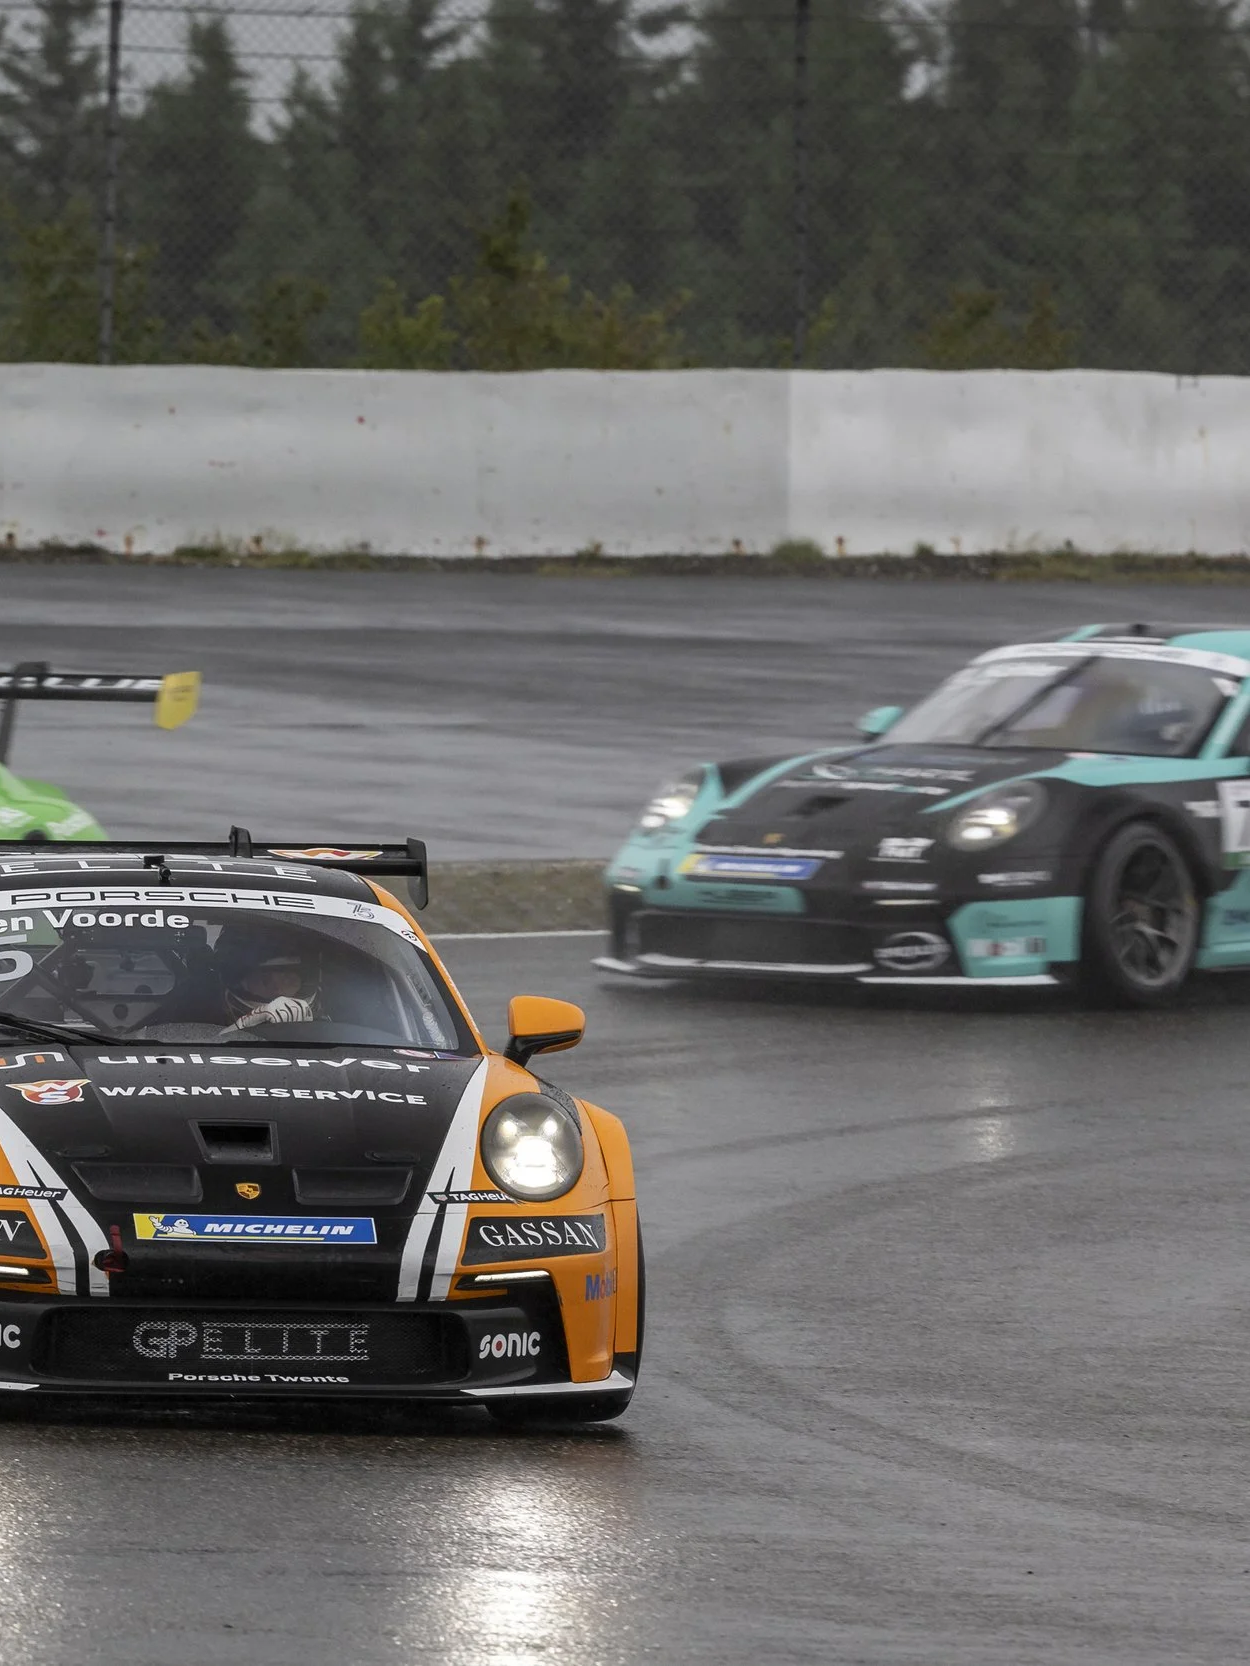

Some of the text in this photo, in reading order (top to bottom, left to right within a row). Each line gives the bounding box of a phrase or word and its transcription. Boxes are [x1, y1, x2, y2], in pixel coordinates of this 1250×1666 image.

[0, 859, 314, 881] ELTE
[11, 891, 316, 909] PORSCHE
[43, 909, 190, 928] Voorde
[98, 1053, 430, 1073] uniserver
[99, 1086, 428, 1105] WARMTESERVICE
[203, 1222, 355, 1236] MICHELIN
[479, 1221, 600, 1249] GASSAN
[168, 1372, 350, 1384] Porsche Twente
